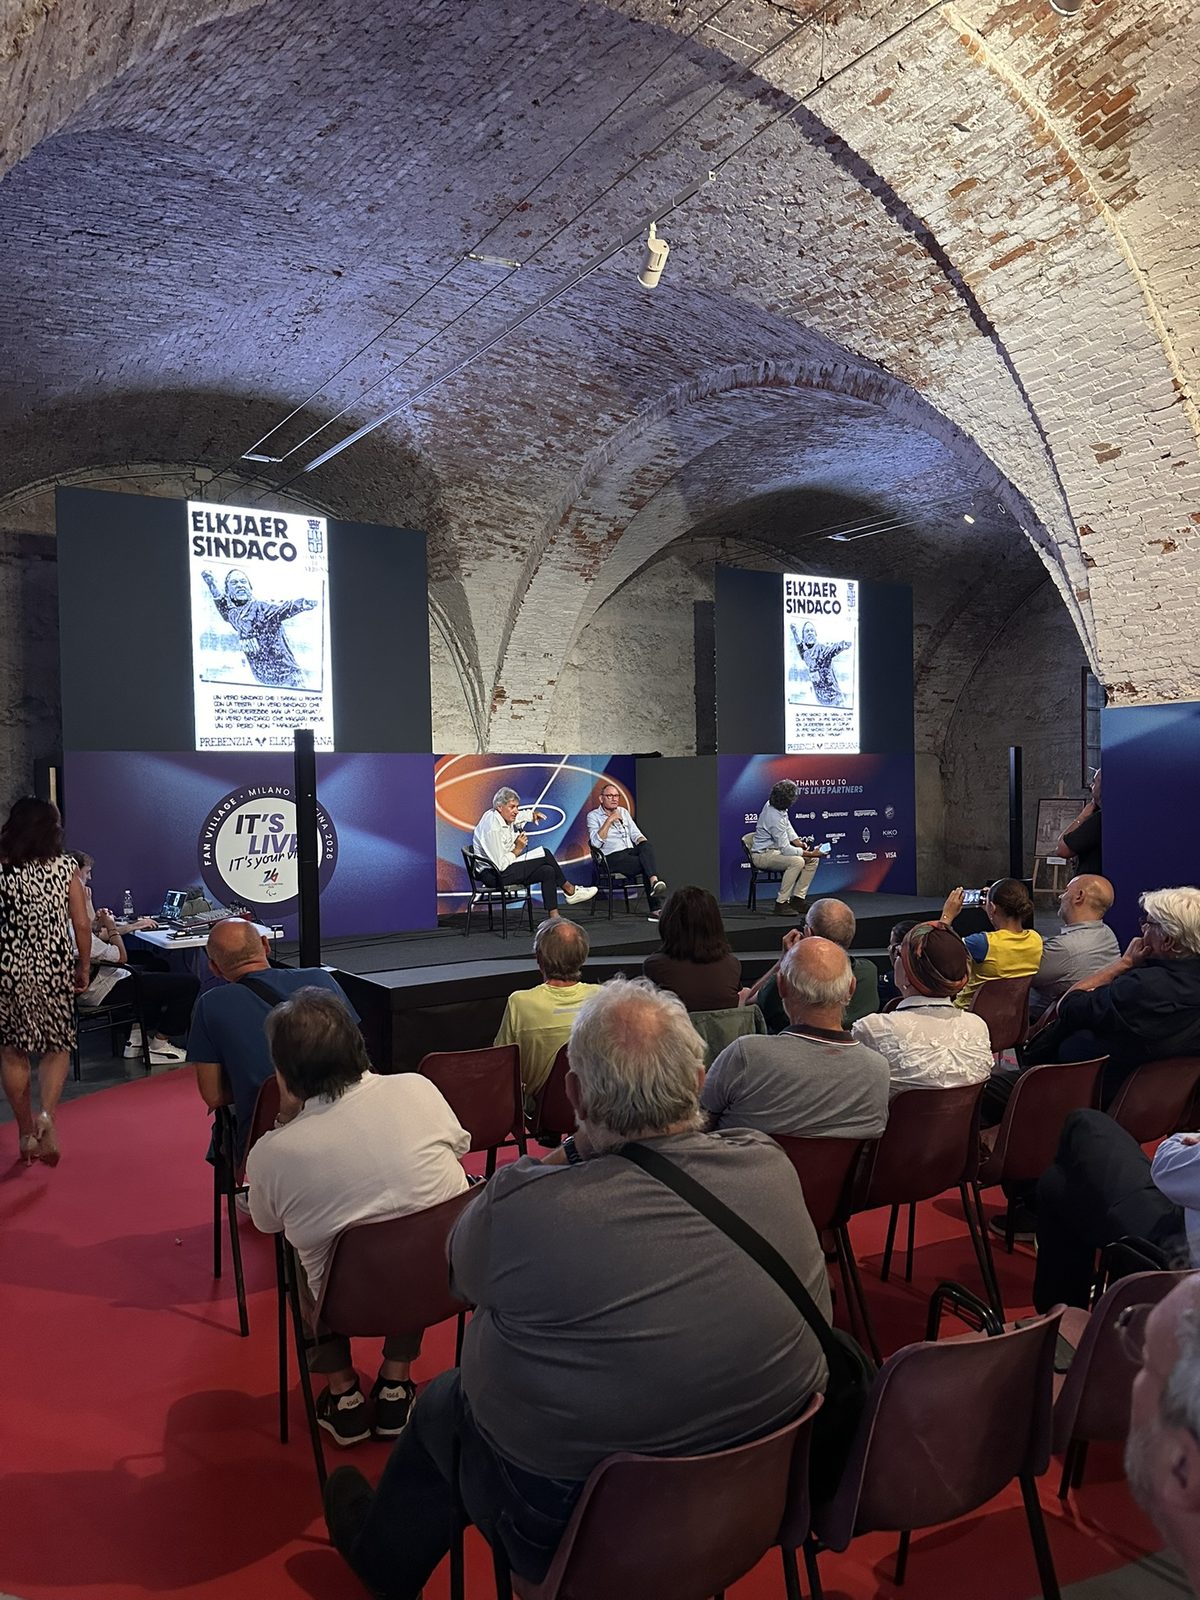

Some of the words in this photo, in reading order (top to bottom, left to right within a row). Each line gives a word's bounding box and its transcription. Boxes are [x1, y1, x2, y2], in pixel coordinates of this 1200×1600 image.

[191, 511, 289, 539] ELKJAER
[192, 535, 298, 562] SINDACO
[785, 580, 837, 598] ELKJAER
[785, 598, 842, 615] SINDACO
[199, 736, 253, 747] PREBENZIA
[248, 785, 291, 798] MILANO
[795, 779, 819, 787] THANK
[821, 778, 836, 786] YOU
[810, 786, 826, 795] LIVE
[826, 785, 864, 794] PARTNERS
[205, 796, 238, 839] VILLAGE
[235, 813, 285, 835] IT'S
[203, 842, 212, 867] FAN
[324, 833, 335, 861] 2026
[884, 851, 897, 859] VISA
[253, 852, 285, 871] your
